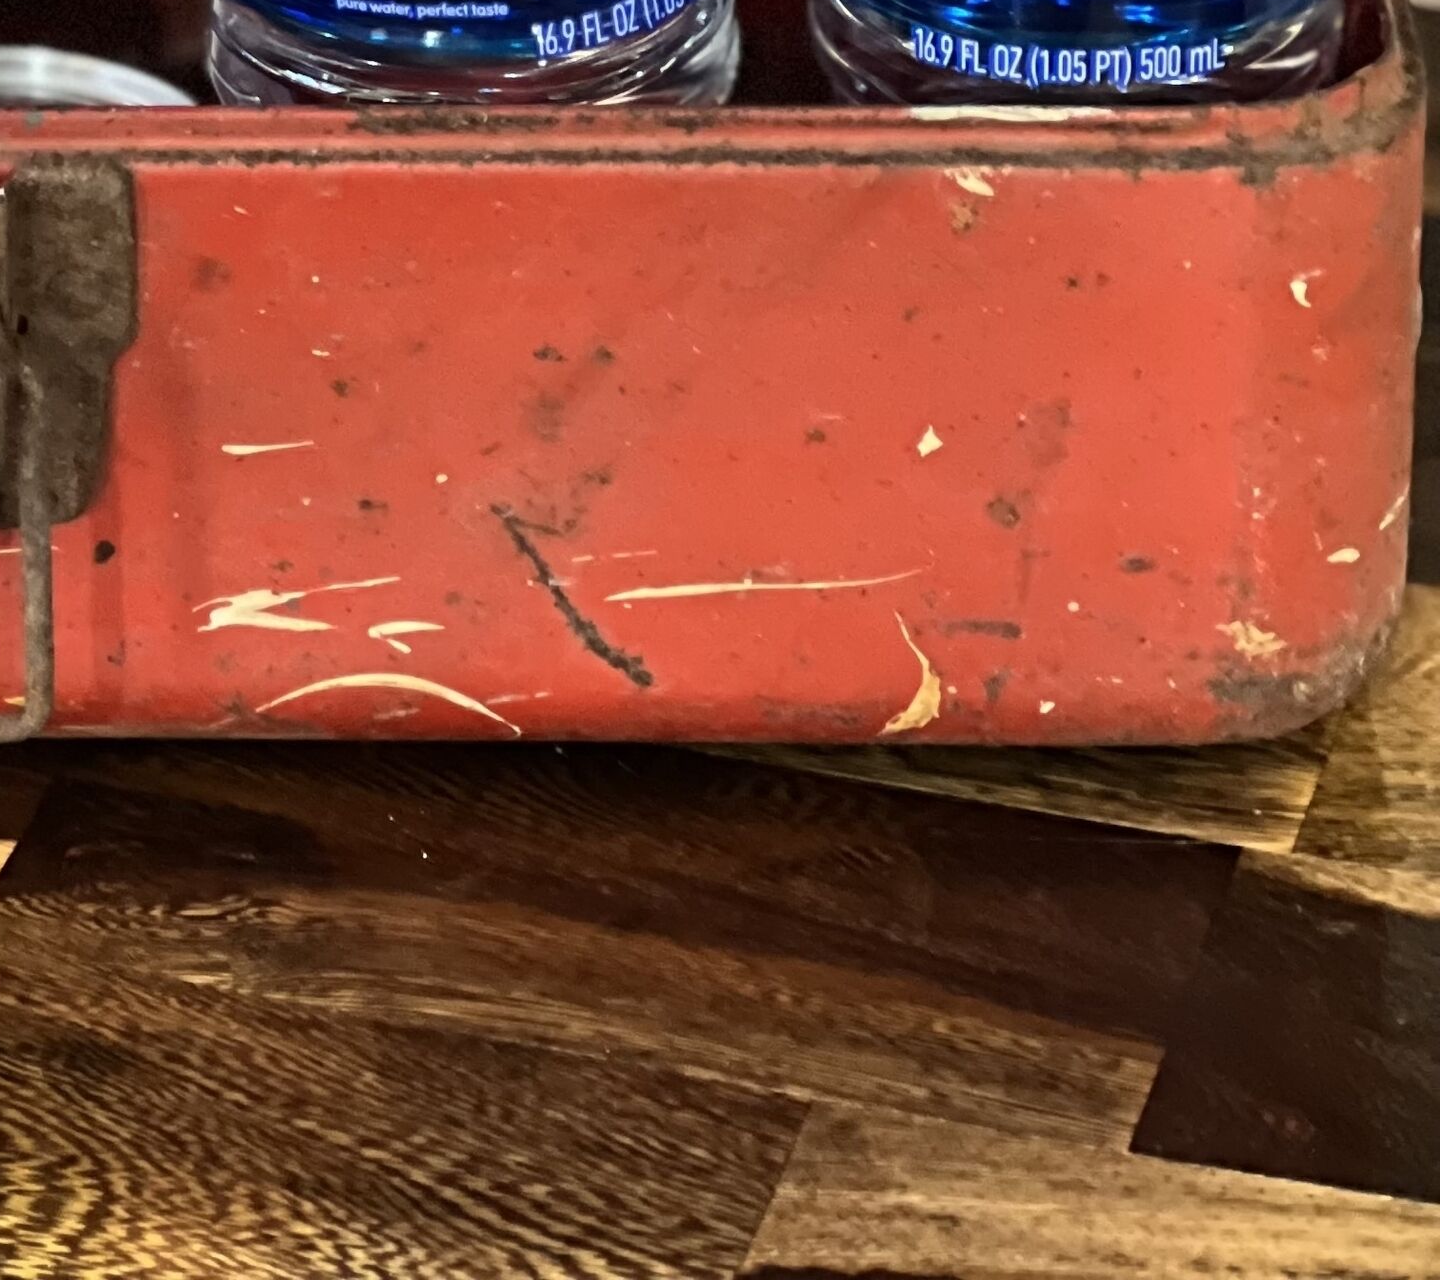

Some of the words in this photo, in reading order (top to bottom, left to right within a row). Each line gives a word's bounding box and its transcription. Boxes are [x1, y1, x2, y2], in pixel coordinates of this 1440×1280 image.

[417, 2, 469, 19] perfect
[471, 1, 508, 17] taste
[534, 18, 575, 56] 16.9
[582, 10, 610, 47] FL
[914, 28, 954, 67] 16.9
[961, 39, 987, 74] FL
[994, 44, 1023, 80] OZ
[1030, 46, 1087, 86] (1.05
[1095, 46, 1133, 87] PT)
[1140, 45, 1182, 81] 500
[1189, 38, 1226, 74] mL
